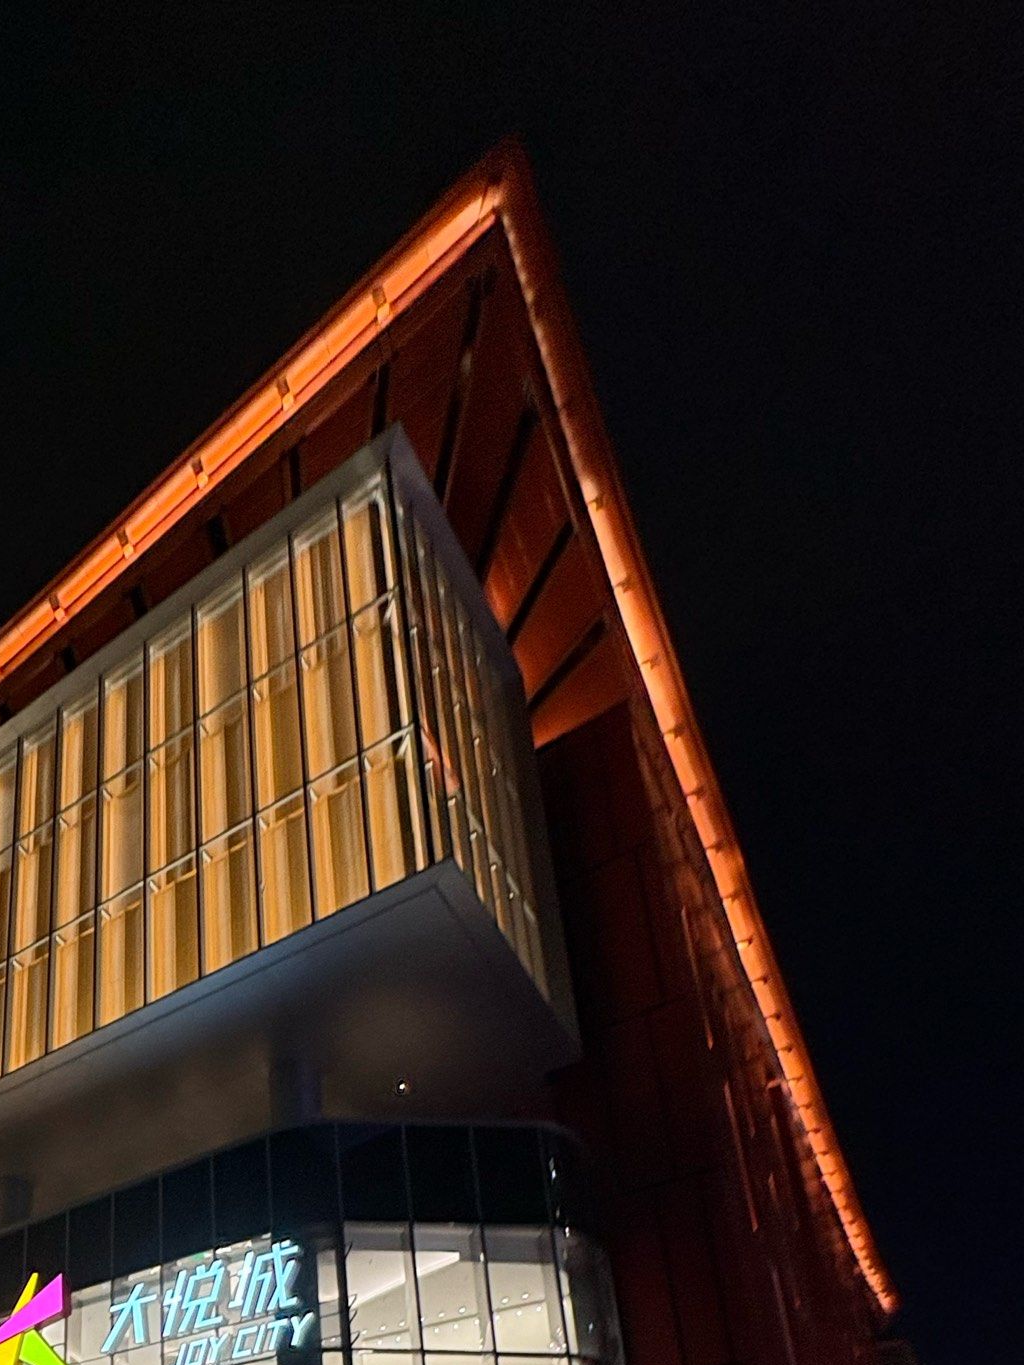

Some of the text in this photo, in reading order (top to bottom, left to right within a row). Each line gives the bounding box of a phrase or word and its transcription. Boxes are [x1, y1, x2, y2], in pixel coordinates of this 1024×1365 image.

[101, 1239, 300, 1353] 大悦城
[231, 1311, 315, 1360] CITY
